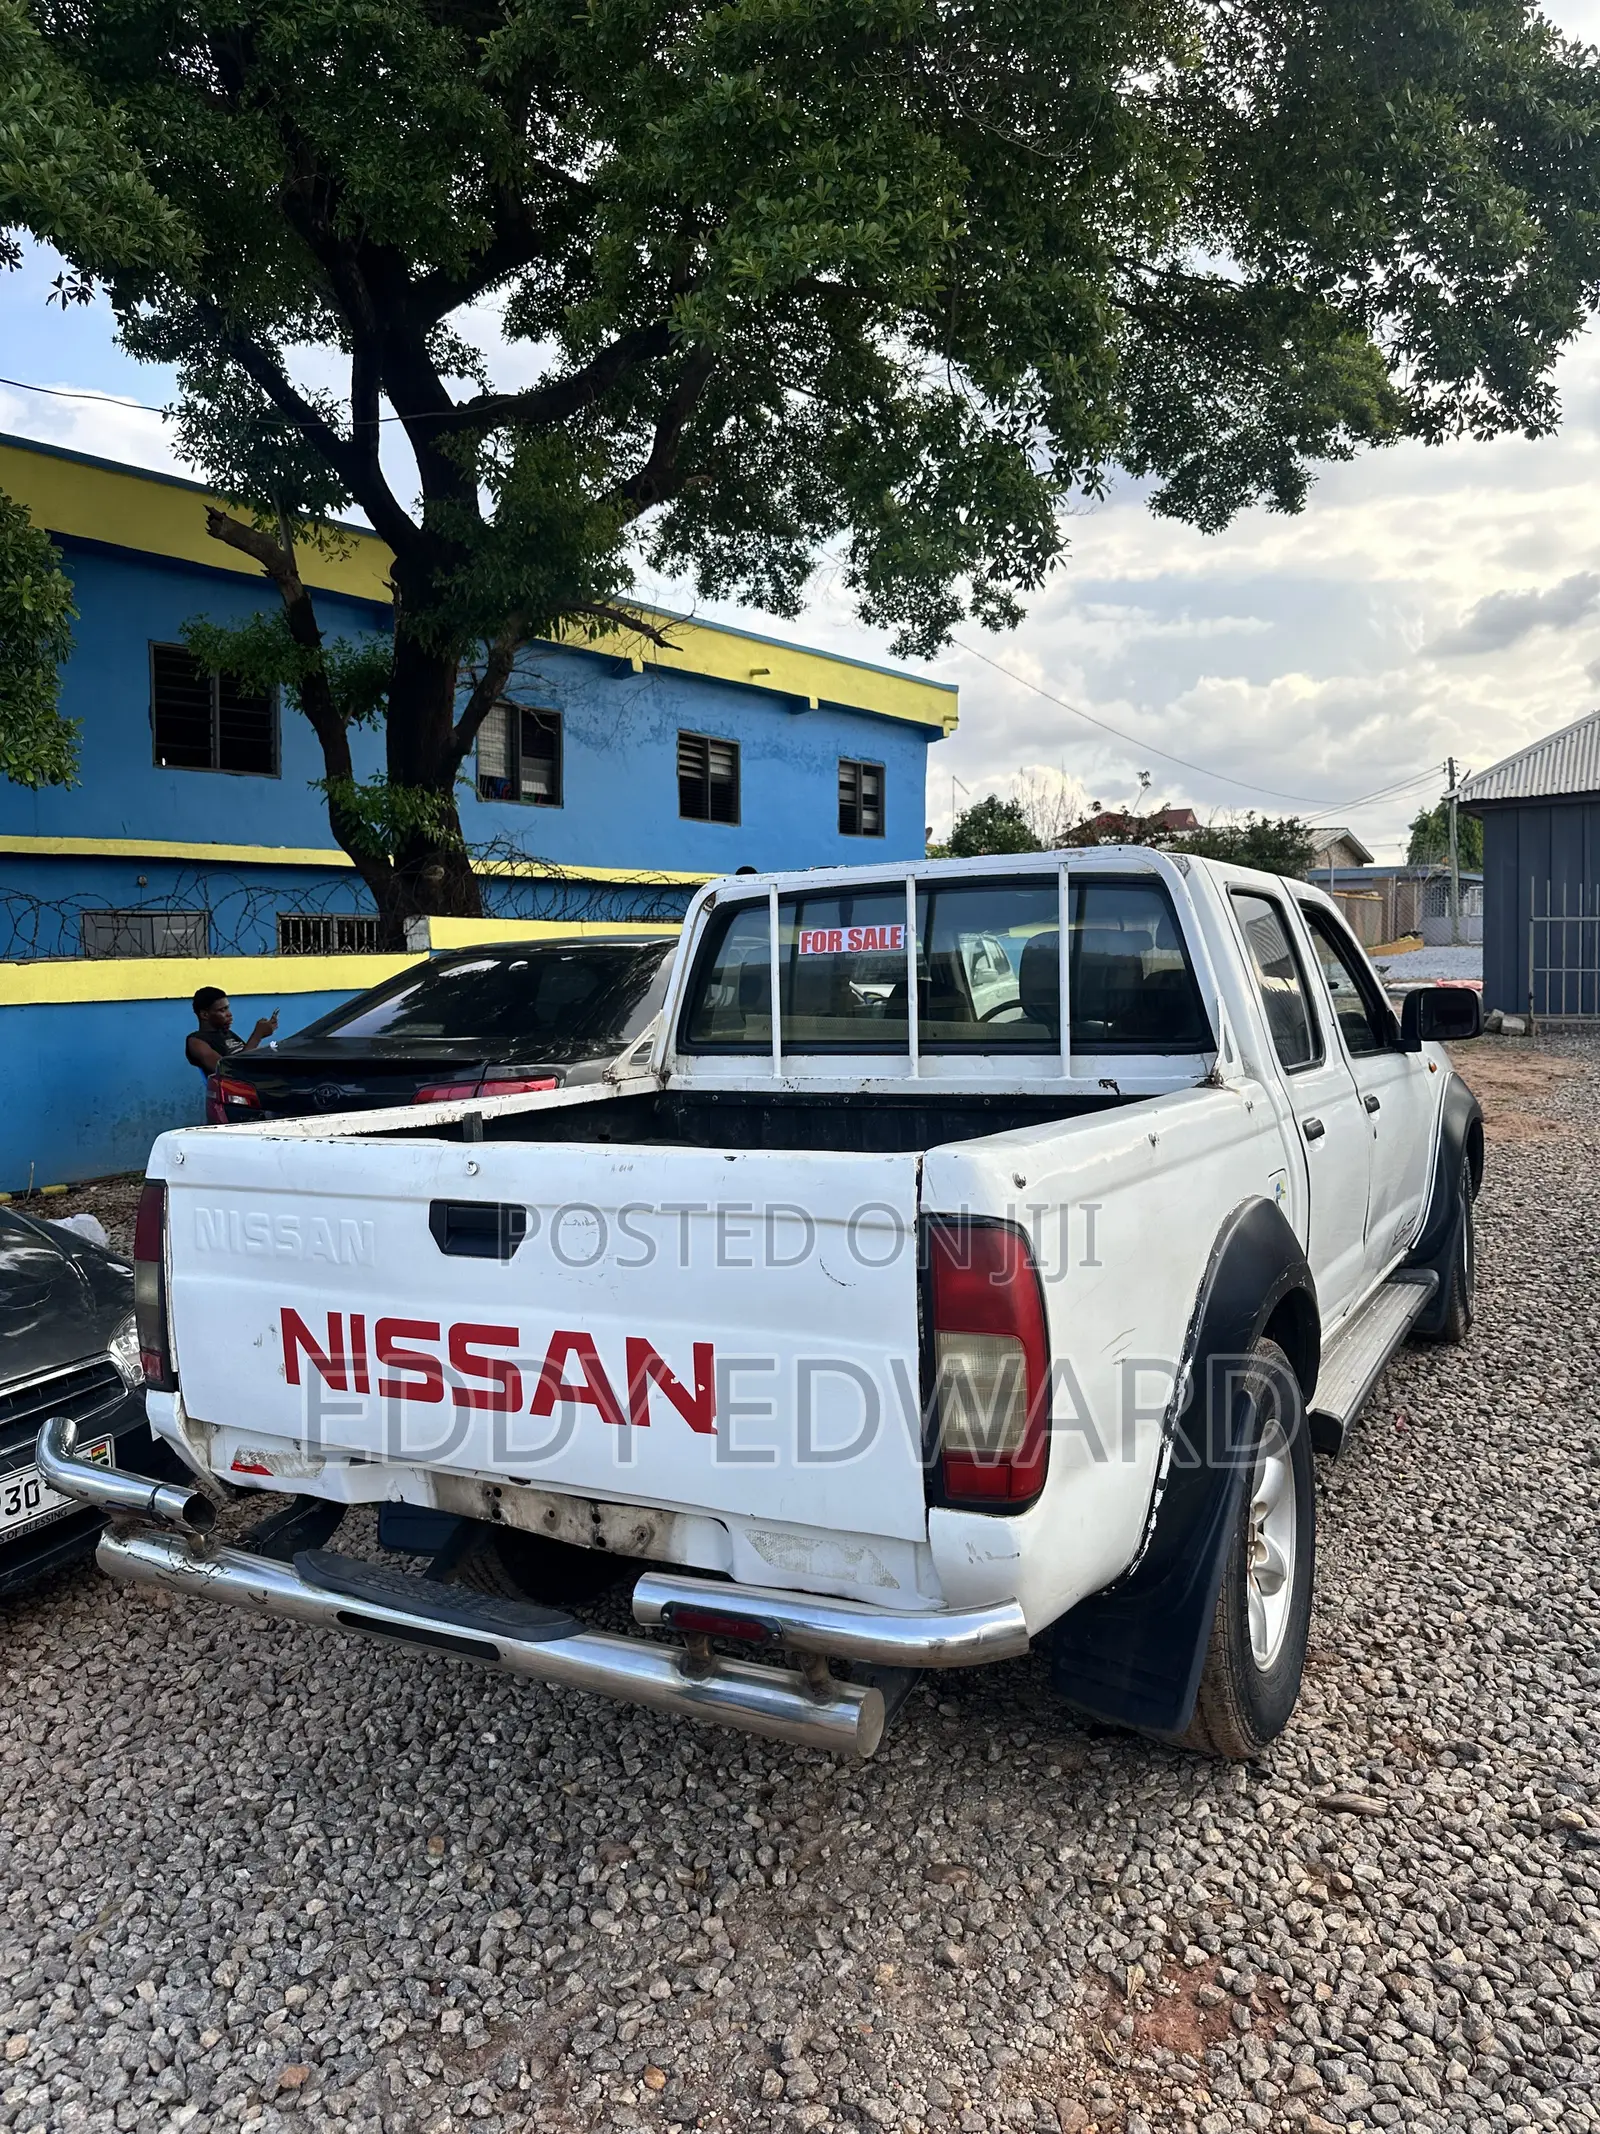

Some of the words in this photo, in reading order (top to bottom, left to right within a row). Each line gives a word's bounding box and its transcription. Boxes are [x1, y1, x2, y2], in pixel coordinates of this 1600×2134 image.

[801, 930, 843, 954] FOR
[847, 926, 902, 952] SALE
[194, 1206, 376, 1268] NISSAN
[279, 1306, 718, 1436] NISSAN
[2, 1478, 40, 1516] 30
[6, 1528, 20, 1540] OF
[23, 1508, 67, 1533] BLESSING
